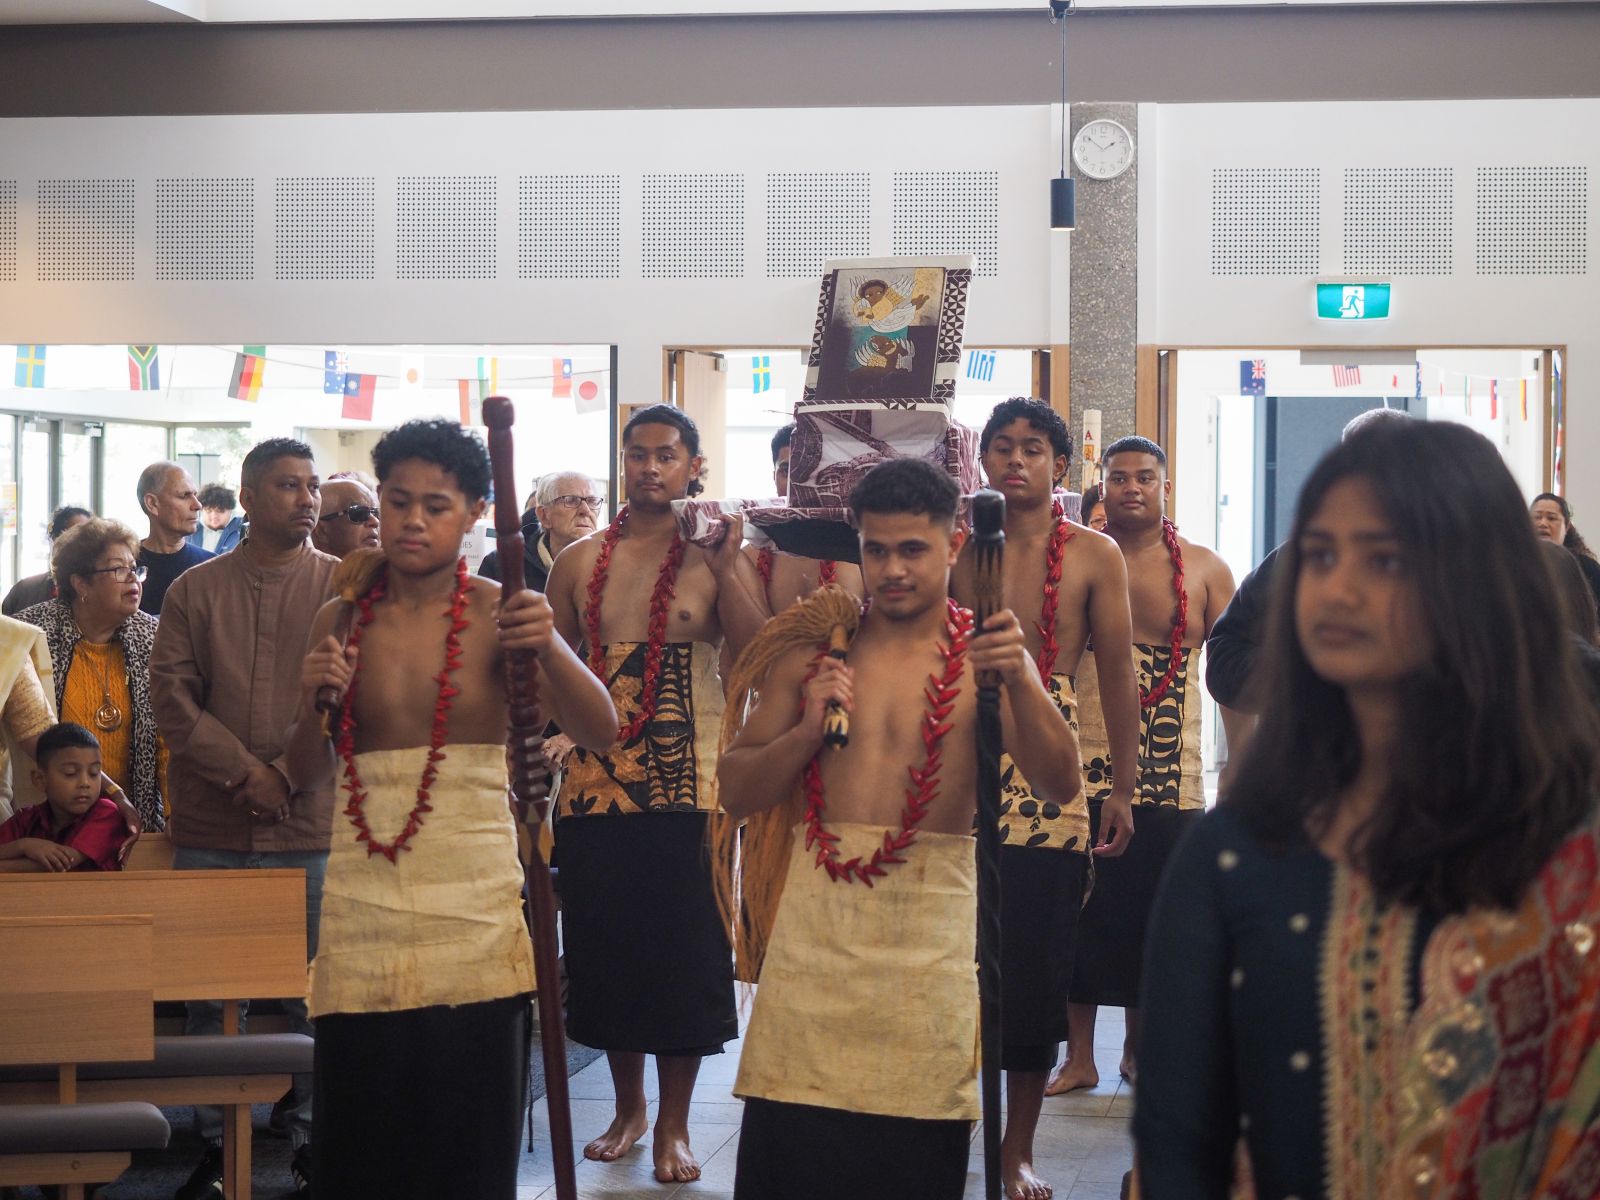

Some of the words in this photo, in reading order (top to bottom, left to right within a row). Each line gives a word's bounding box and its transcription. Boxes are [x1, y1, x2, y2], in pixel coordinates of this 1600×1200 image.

[1100, 126, 1108, 134] 12
[1119, 135, 1125, 143] 2
[1082, 156, 1088, 164] 8
[1099, 167, 1105, 175] 6
[1085, 430, 1093, 440] A
[461, 541, 473, 549] IES
